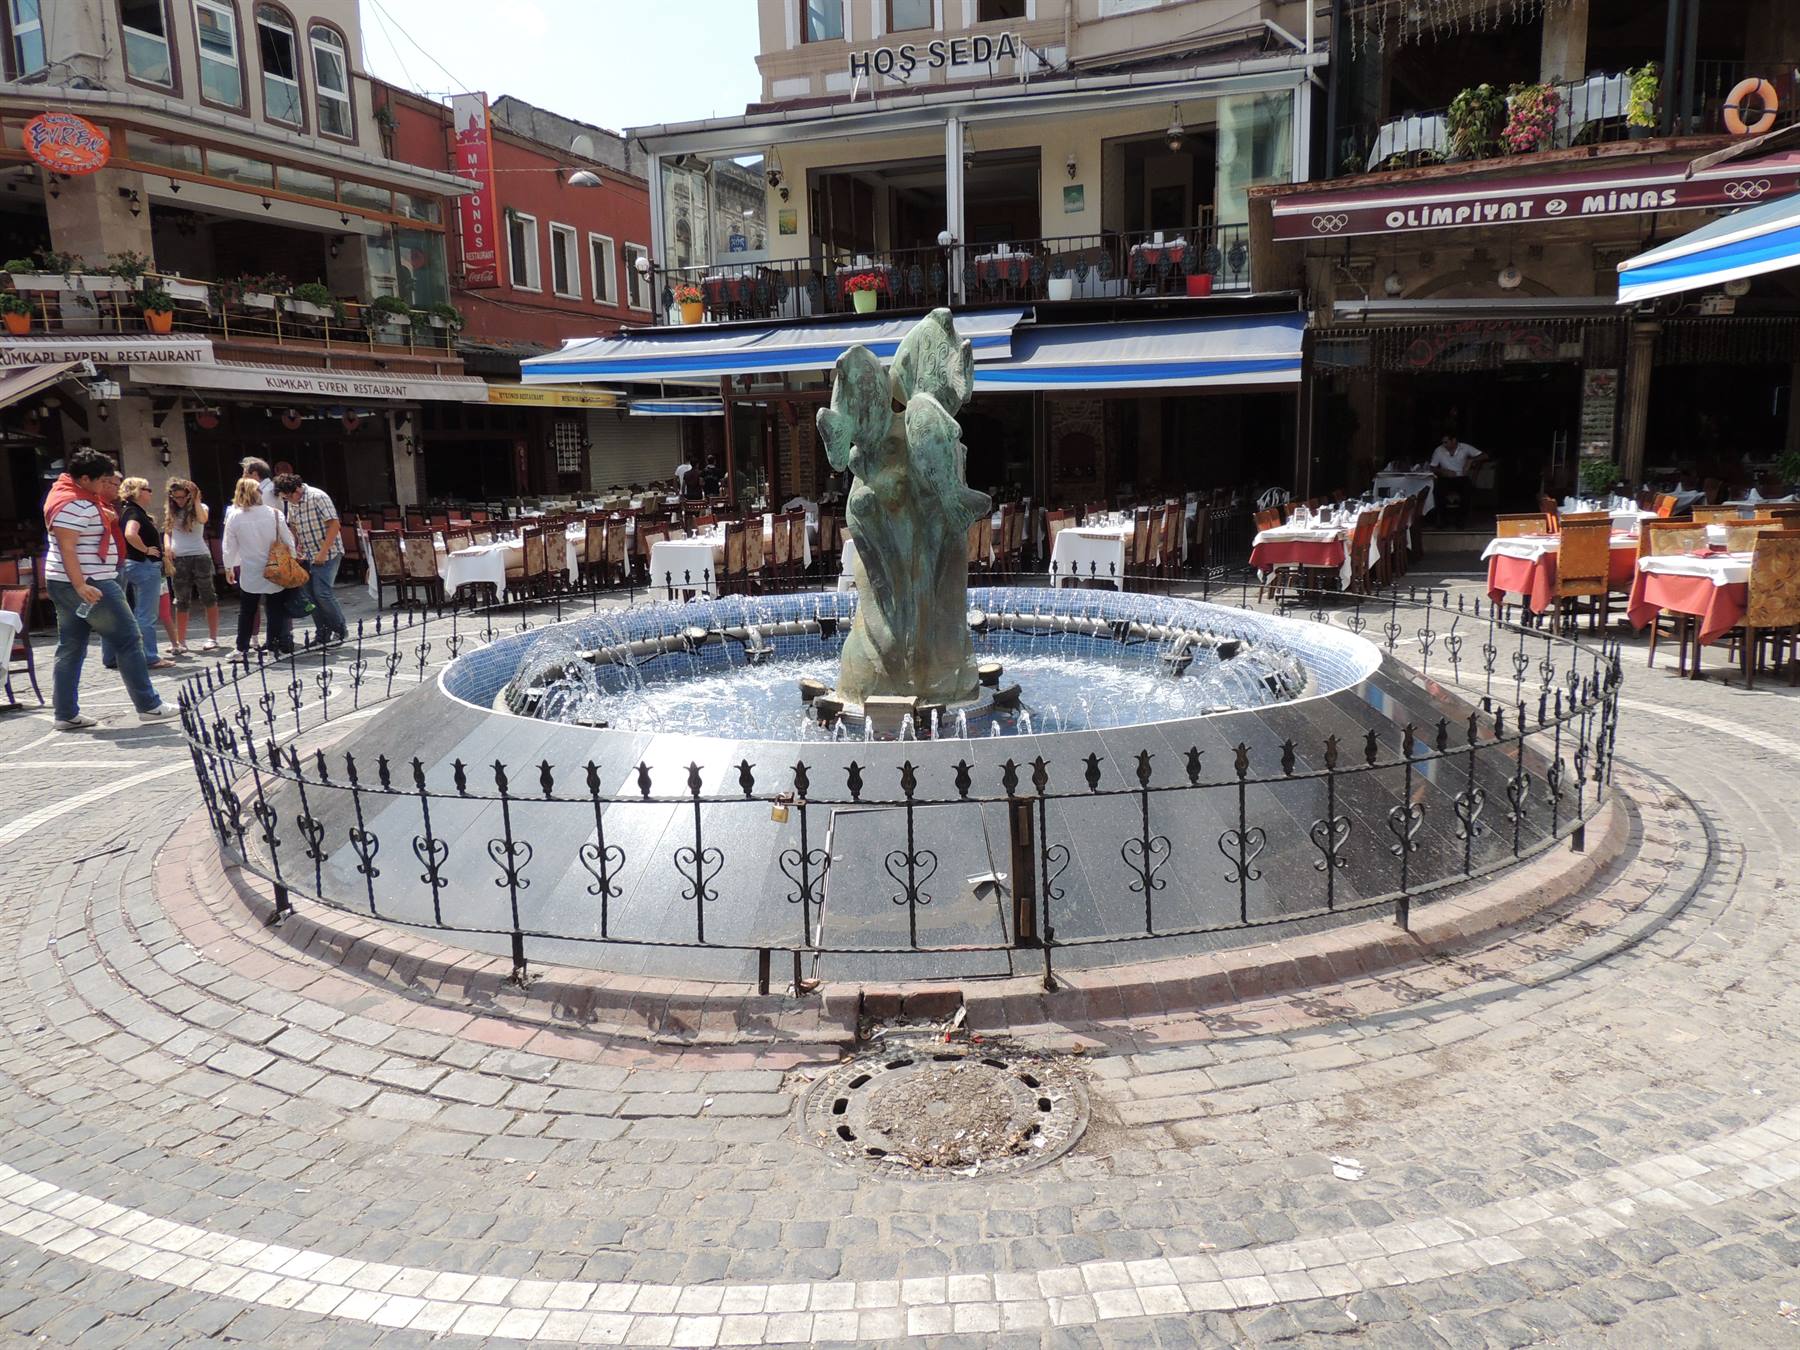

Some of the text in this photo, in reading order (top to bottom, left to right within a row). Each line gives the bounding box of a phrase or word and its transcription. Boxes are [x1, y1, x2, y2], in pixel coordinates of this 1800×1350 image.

[850, 31, 1018, 79] HOŞ SEDA
[467, 153, 484, 248] MYONOS
[1385, 189, 1677, 228] OLİMPİYAT 2 MİNAS
[465, 250, 494, 261] RESTAURANT
[64, 351, 109, 363] EVREN
[118, 350, 202, 363] RESTAURANT
[265, 376, 408, 397] KUMKAPI EVREN RESTAURANT
